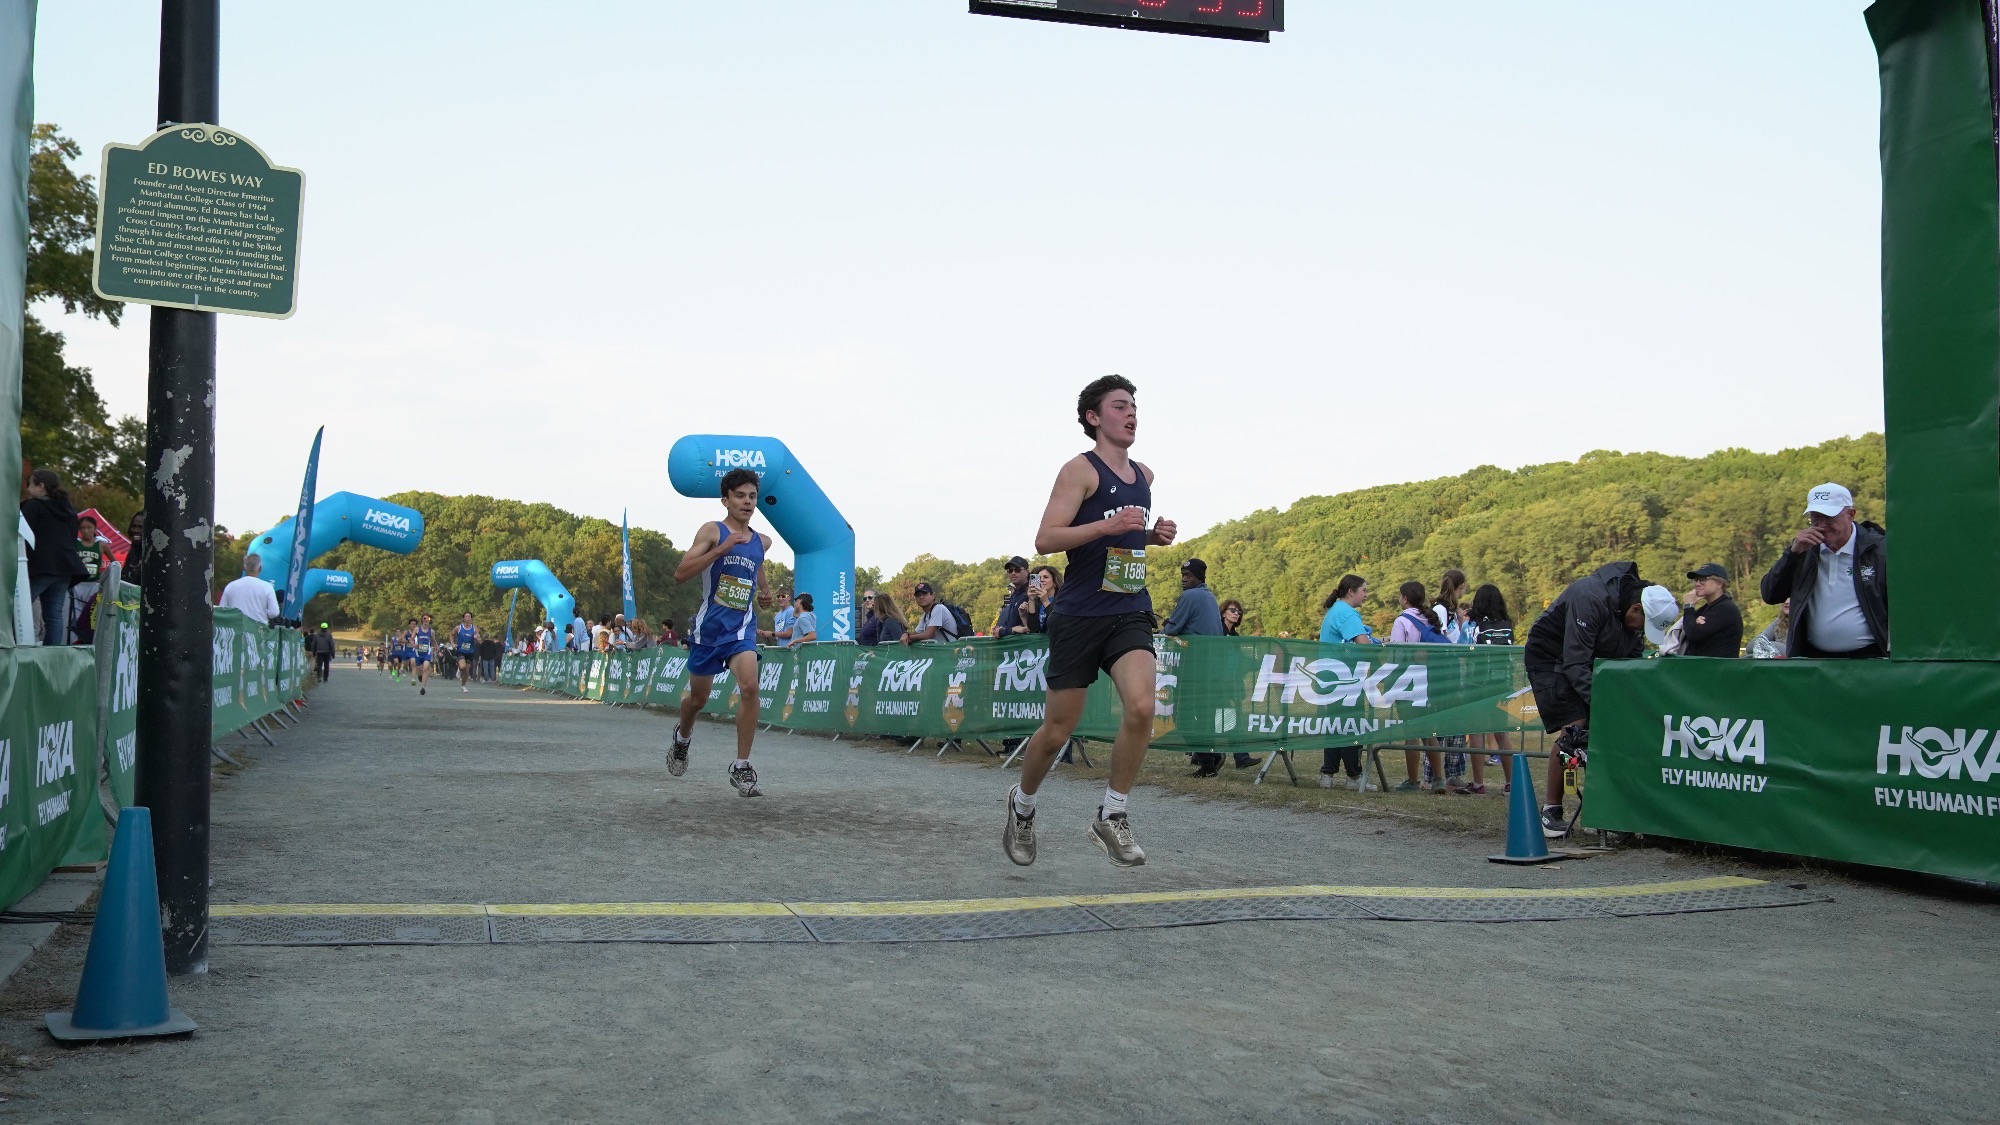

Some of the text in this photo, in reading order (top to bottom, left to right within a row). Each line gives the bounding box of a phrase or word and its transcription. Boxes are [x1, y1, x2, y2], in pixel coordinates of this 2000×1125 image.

[148, 162, 264, 188] ED BOWES WAY
[133, 177, 275, 203] Founder and Meet Director Emeritus
[140, 189, 267, 211] Manhattan College Class of 1964
[118, 206, 155, 217] profound
[157, 209, 184, 221] impact
[198, 215, 211, 224] the
[212, 217, 254, 229] Manhattan
[256, 223, 285, 234] College
[138, 199, 162, 208] proud
[163, 201, 199, 214] alumnus,
[201, 206, 211, 214] Ed
[213, 207, 238, 218] Bowes
[239, 210, 253, 220] has
[254, 212, 269, 222] had
[118, 225, 282, 252] through his dedicated efforts to the Spiked
[125, 216, 276, 242] Cross Country, Track and Field program
[108, 244, 287, 272] Manhattan College Cross Country Invitational.
[114, 234, 284, 262] Shoe Club and most notably in founding the
[111, 254, 284, 281] From modest beginnings, the invitational has
[122, 266, 148, 275] grown
[150, 267, 166, 277] into
[184, 272, 194, 280] of
[195, 273, 208, 282] the
[209, 274, 235, 286] largest
[236, 279, 252, 287] and
[133, 278, 260, 299] competitive races in the country.
[715, 449, 766, 467] HOKA
[362, 523, 407, 539] FLY HUMAN FLY
[365, 508, 409, 532] HOKA
[326, 575, 348, 583] HOKA
[495, 565, 519, 575] HOKA
[1123, 562, 1145, 580] 1589
[728, 586, 750, 601] 5366
[833, 591, 841, 605] FLY
[833, 607, 851, 641] KA
[805, 659, 836, 693] HOKA
[878, 658, 933, 692] HOKA
[993, 648, 1050, 692] HOK
[1251, 654, 1428, 708] HOKA
[875, 700, 919, 716] FLY HUMAN FLY
[993, 702, 1046, 719] FLY HUMAN
[1248, 714, 1284, 733] FLY
[1287, 716, 1379, 736] HUMAN
[1661, 715, 1765, 765] HOKA
[36, 720, 75, 787] HOKA
[1661, 768, 1767, 793] FLY HUMAN FLY
[1874, 787, 1904, 808] FLY
[1907, 789, 1984, 816] HUMAN
